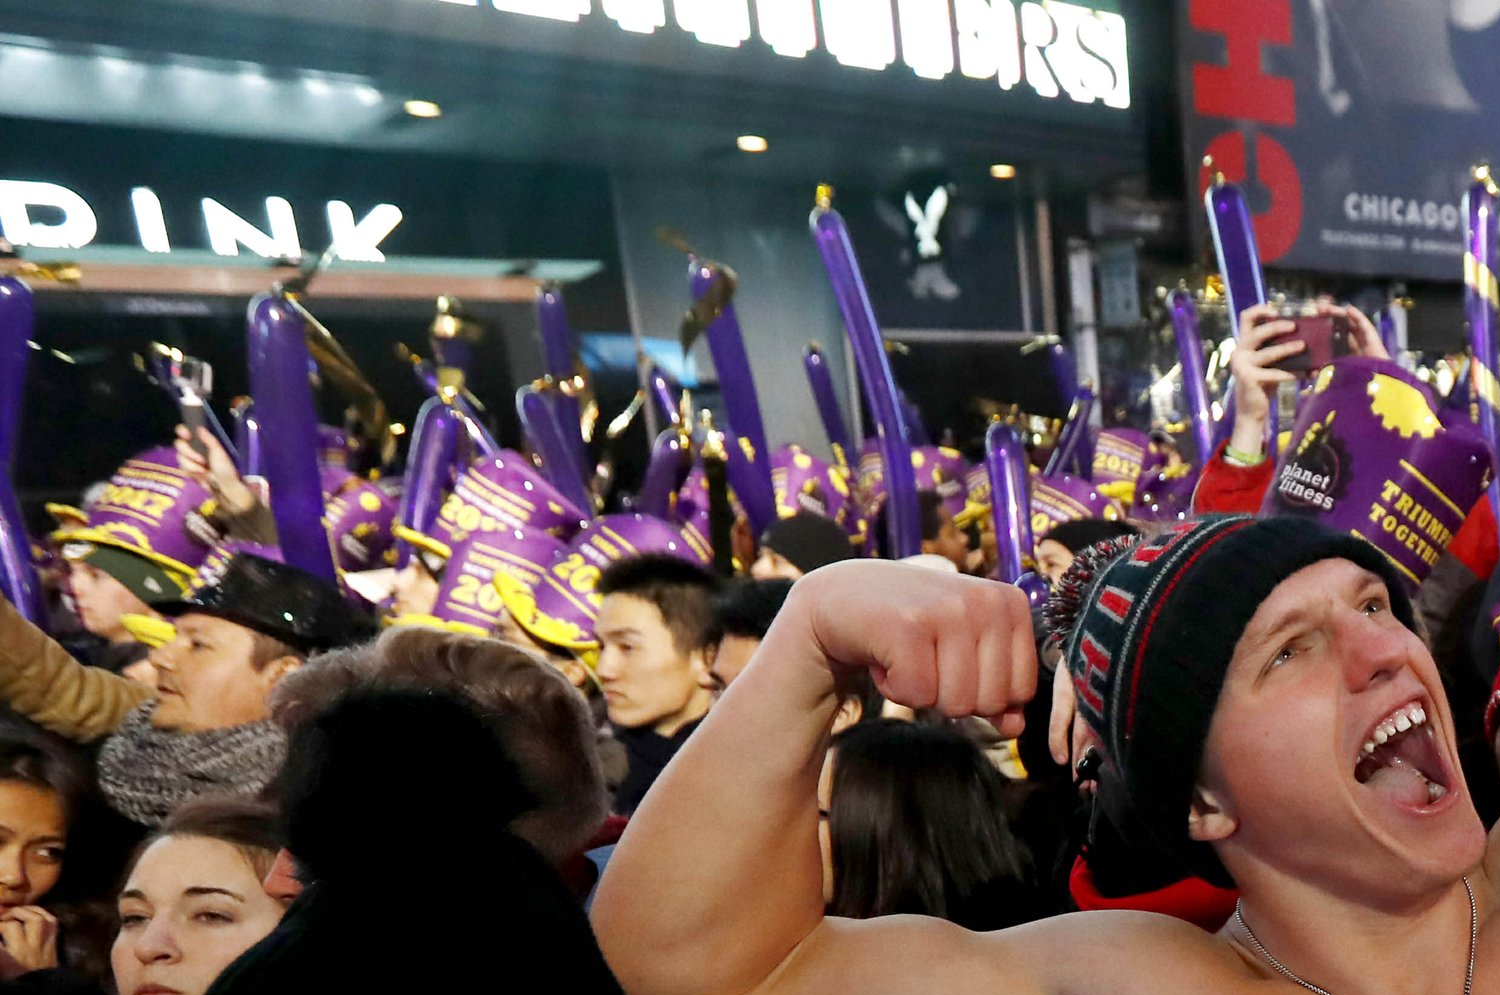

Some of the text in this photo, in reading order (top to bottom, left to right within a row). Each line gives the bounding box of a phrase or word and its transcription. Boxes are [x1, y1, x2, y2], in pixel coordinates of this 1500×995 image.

[1280, 461, 1330, 490] planet
[1278, 476, 1334, 511] fitness
[1368, 501, 1440, 566] TOGETHE
